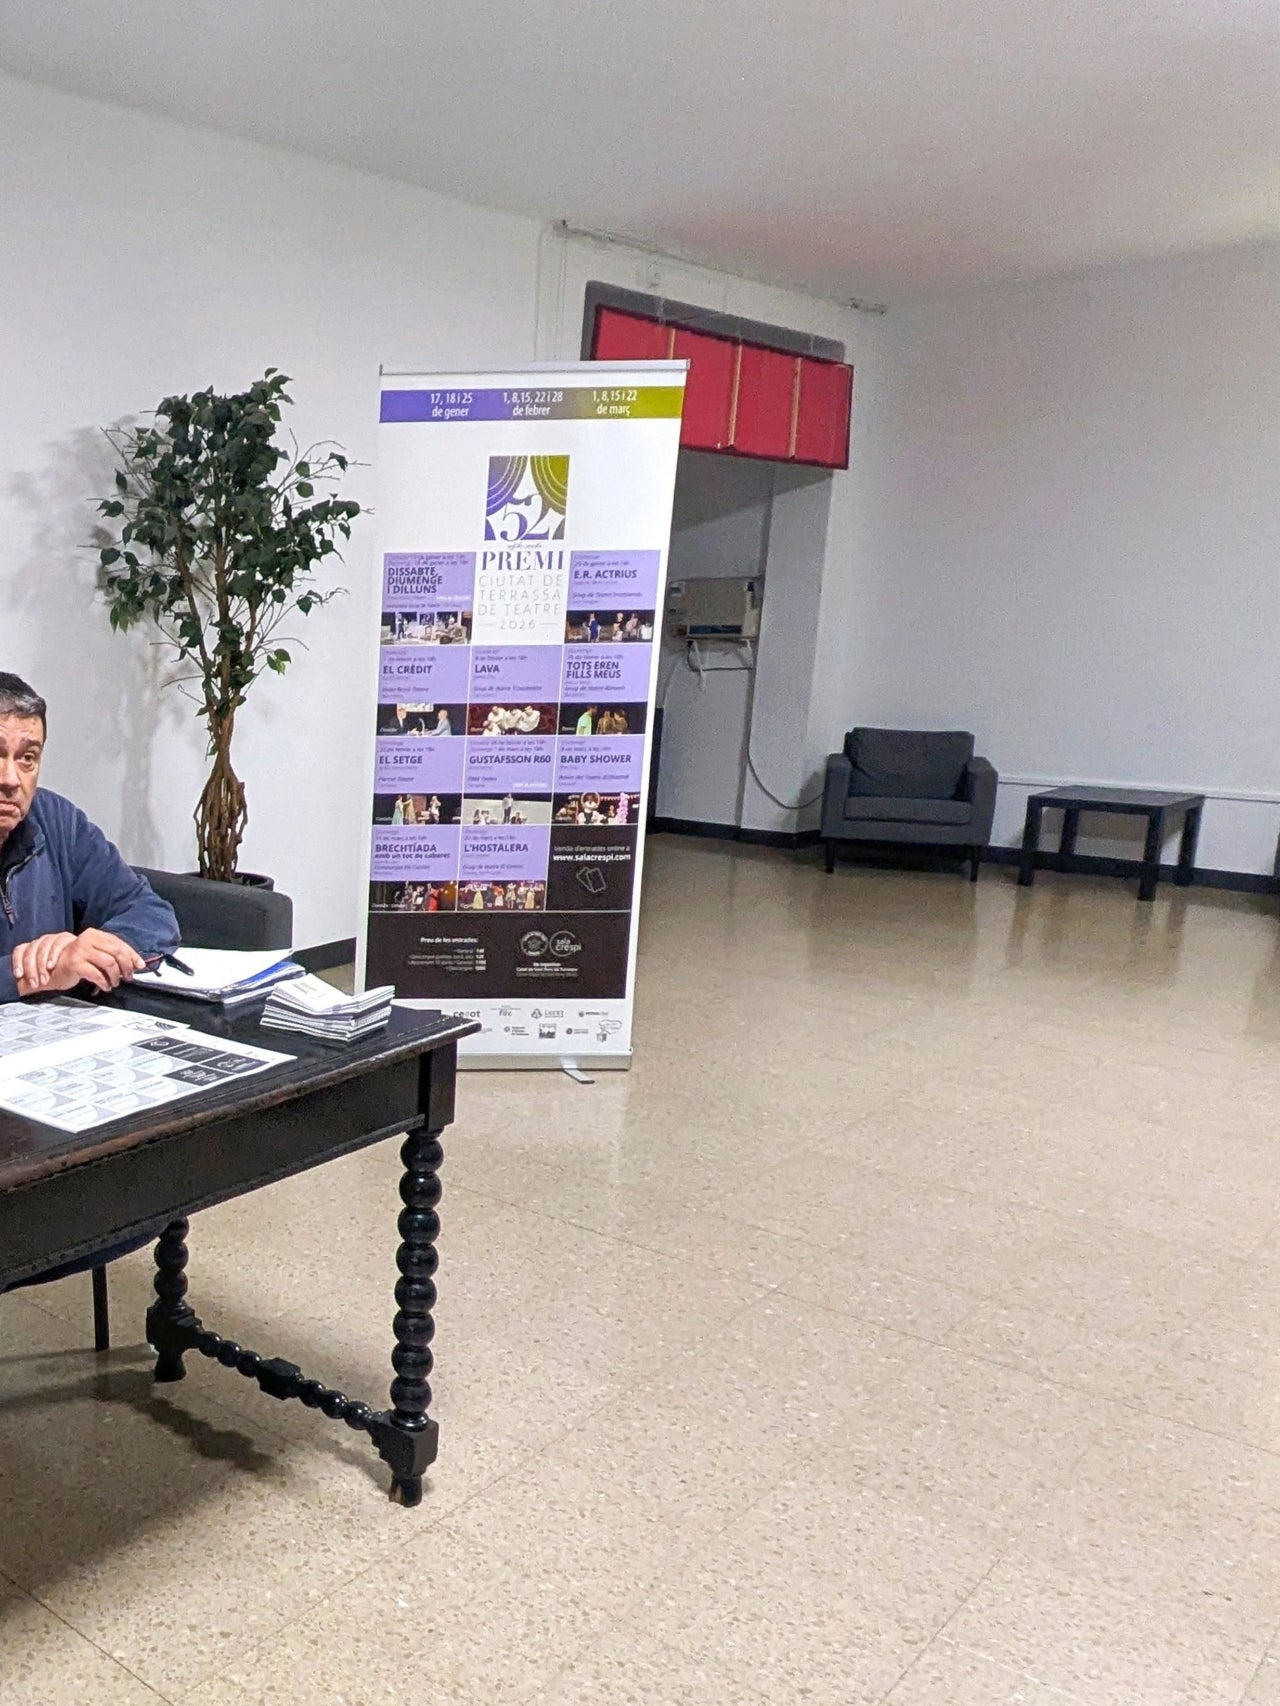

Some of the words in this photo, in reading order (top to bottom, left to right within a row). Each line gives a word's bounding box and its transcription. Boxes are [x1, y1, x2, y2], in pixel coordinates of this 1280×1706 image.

[430, 392, 443, 405] 17,
[446, 392, 455, 403] 18
[461, 392, 473, 404] 25
[535, 391, 546, 403] 22
[551, 391, 564, 402] 28
[626, 389, 638, 401] 22
[432, 405, 443, 417] de
[444, 406, 470, 420] gener
[512, 405, 524, 416] de
[524, 404, 551, 416] febrer
[596, 404, 608, 415] de
[608, 404, 630, 416] març
[500, 494, 550, 541] 52
[482, 550, 564, 570] PREMI
[387, 567, 439, 577] DISSABTE,
[574, 570, 592, 579] E.R.
[595, 569, 637, 579] ACTRIUS
[387, 576, 443, 585] DIUMENGE
[478, 575, 535, 587] CIUTAT
[543, 574, 564, 587] DE
[393, 585, 437, 594] DILLUNS
[480, 589, 561, 601] TERRASSA
[477, 604, 497, 616] DE
[504, 603, 561, 615] TEATRE
[499, 619, 536, 630] 2026
[383, 665, 394, 674] EL
[474, 664, 500, 673] LAVA
[567, 661, 592, 670] TOTS
[594, 661, 619, 670] EREN
[566, 670, 592, 679] FILLS
[593, 670, 622, 679] MEUS
[379, 755, 391, 764] EL
[393, 755, 423, 764] SETGE
[469, 755, 532, 764] GUSTAFSSON
[533, 754, 552, 763] R60
[560, 755, 588, 764] BABY
[589, 754, 632, 763] SHOWER
[464, 843, 529, 853] L'HOSTALERA
[553, 853, 631, 863] www.salacrespi.com
